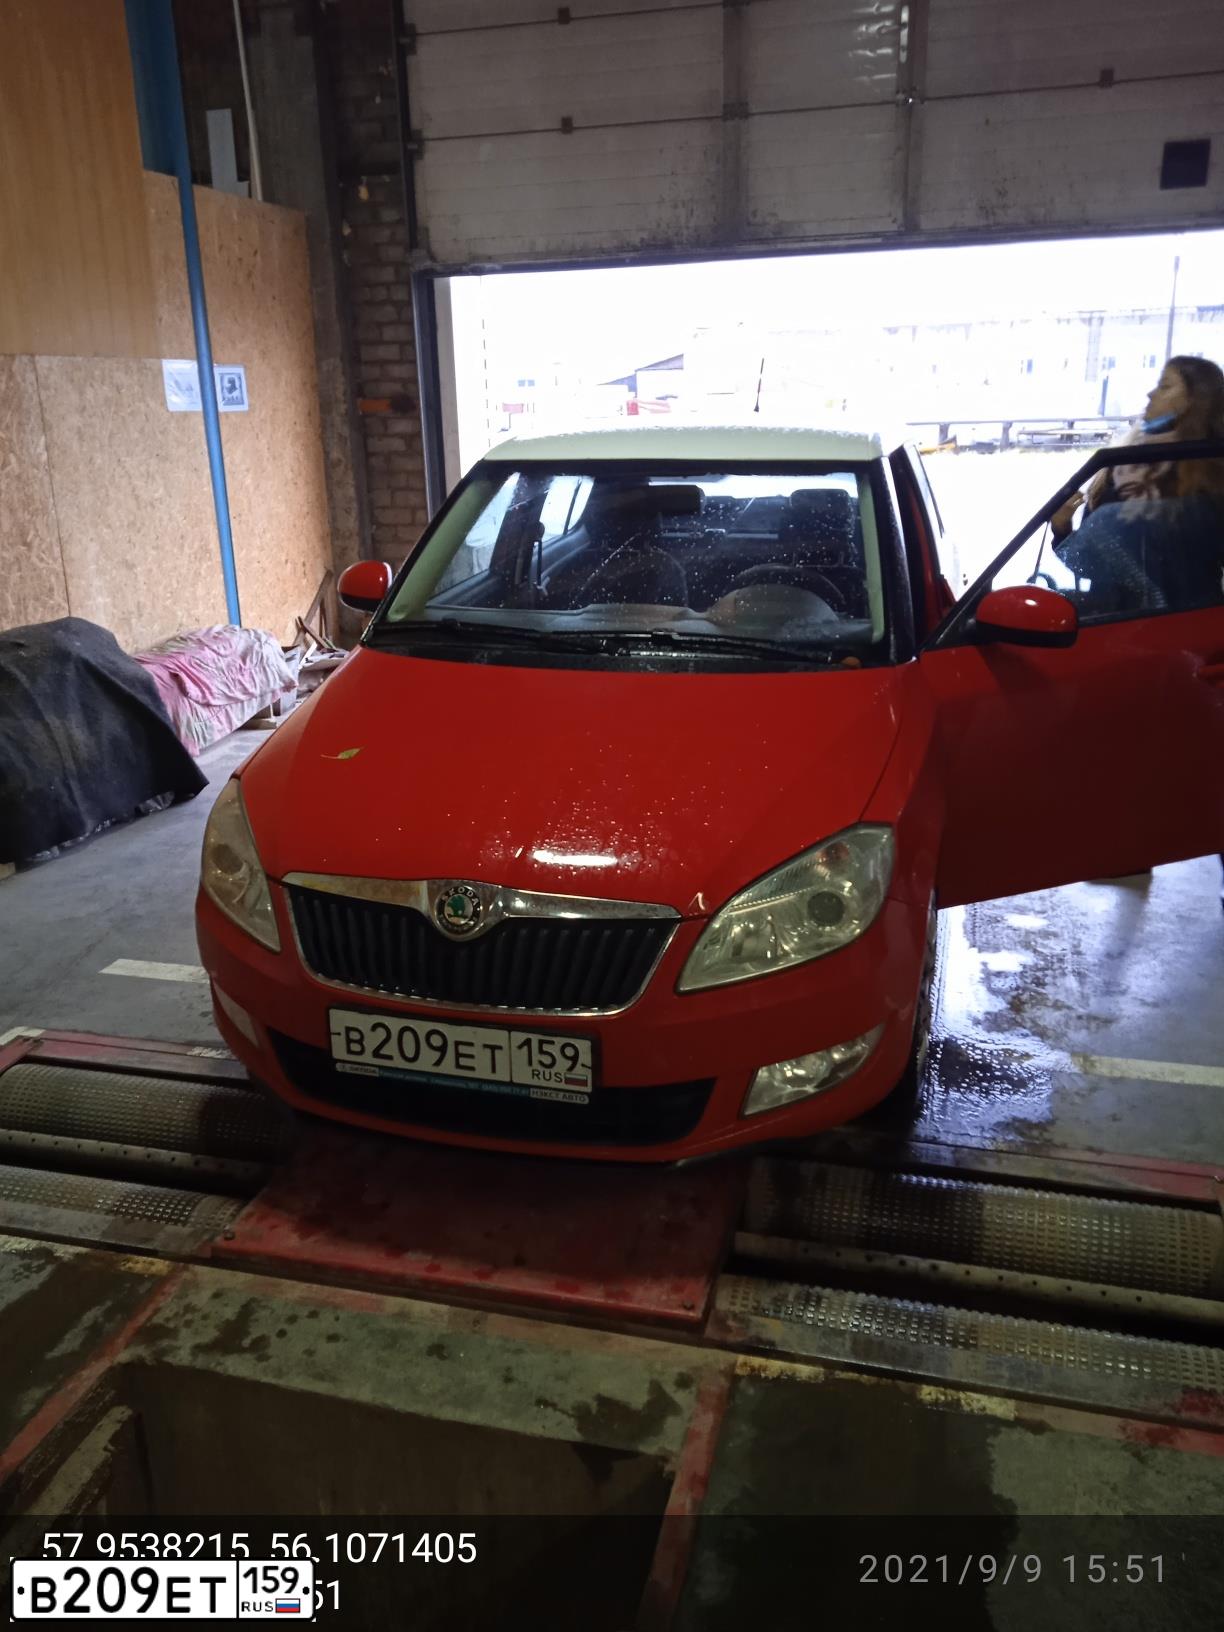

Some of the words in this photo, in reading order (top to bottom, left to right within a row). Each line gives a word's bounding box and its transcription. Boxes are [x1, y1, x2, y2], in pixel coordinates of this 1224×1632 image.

[345, 1022, 503, 1074] В209ЕТ
[516, 1037, 579, 1072] 159
[531, 1068, 563, 1084] RUS
